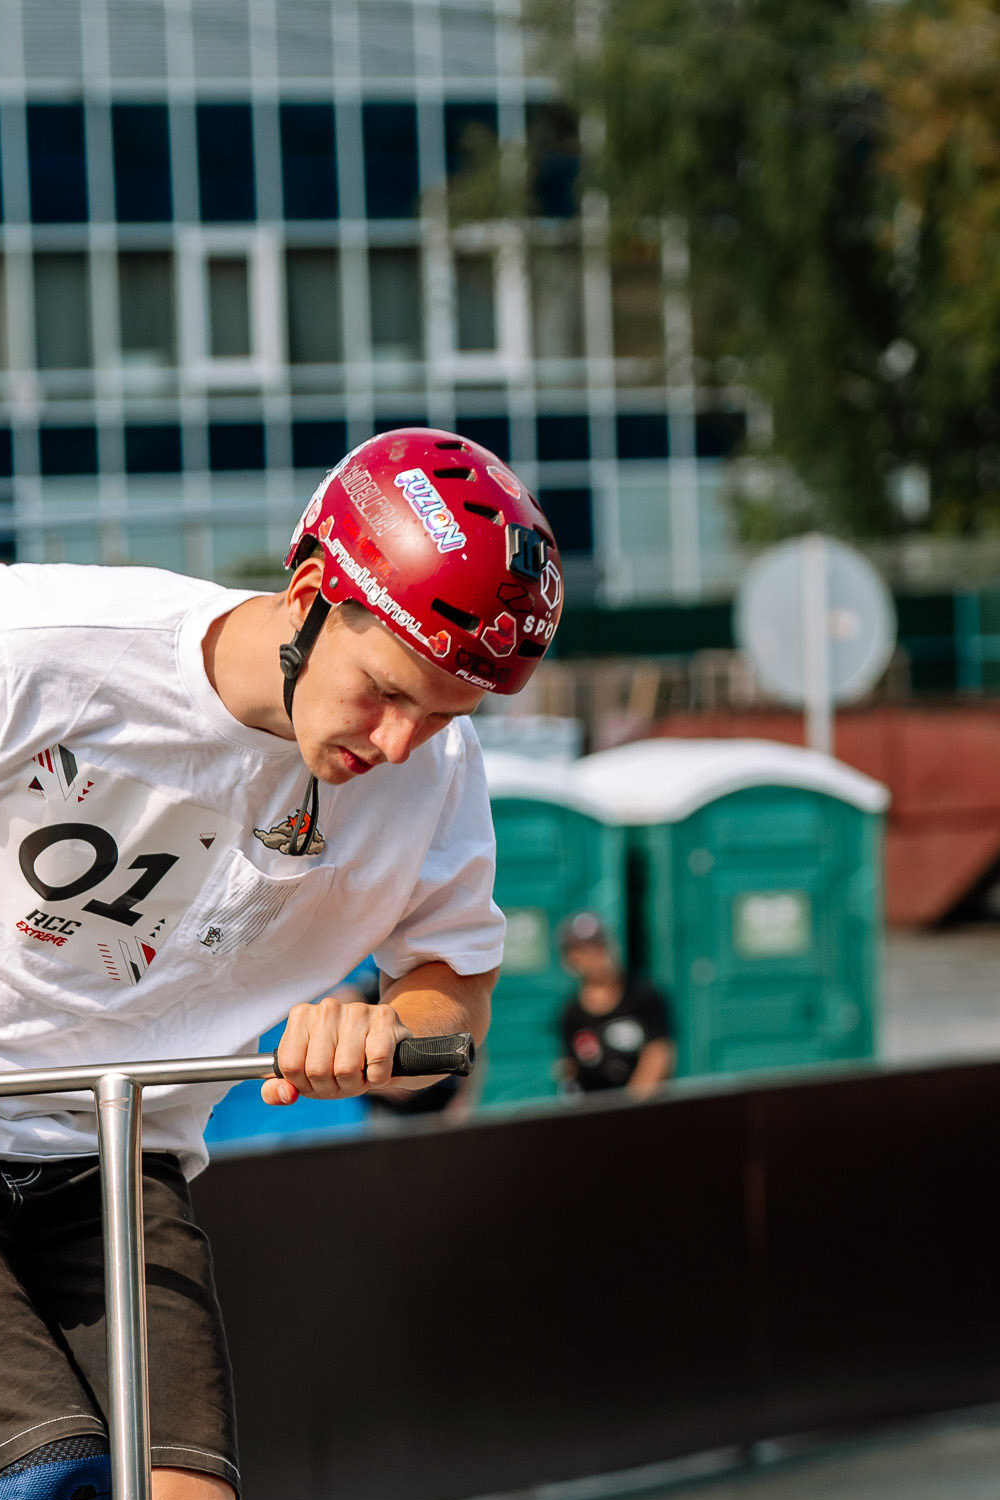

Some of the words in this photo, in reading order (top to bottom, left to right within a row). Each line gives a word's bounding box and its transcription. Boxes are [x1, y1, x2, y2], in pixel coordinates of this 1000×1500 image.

[394, 468, 467, 554] FUZION
[523, 615, 557, 640] SPO
[455, 669, 496, 690] FUZION
[16, 920, 69, 947] EXTREME
[25, 909, 83, 936] RCC
